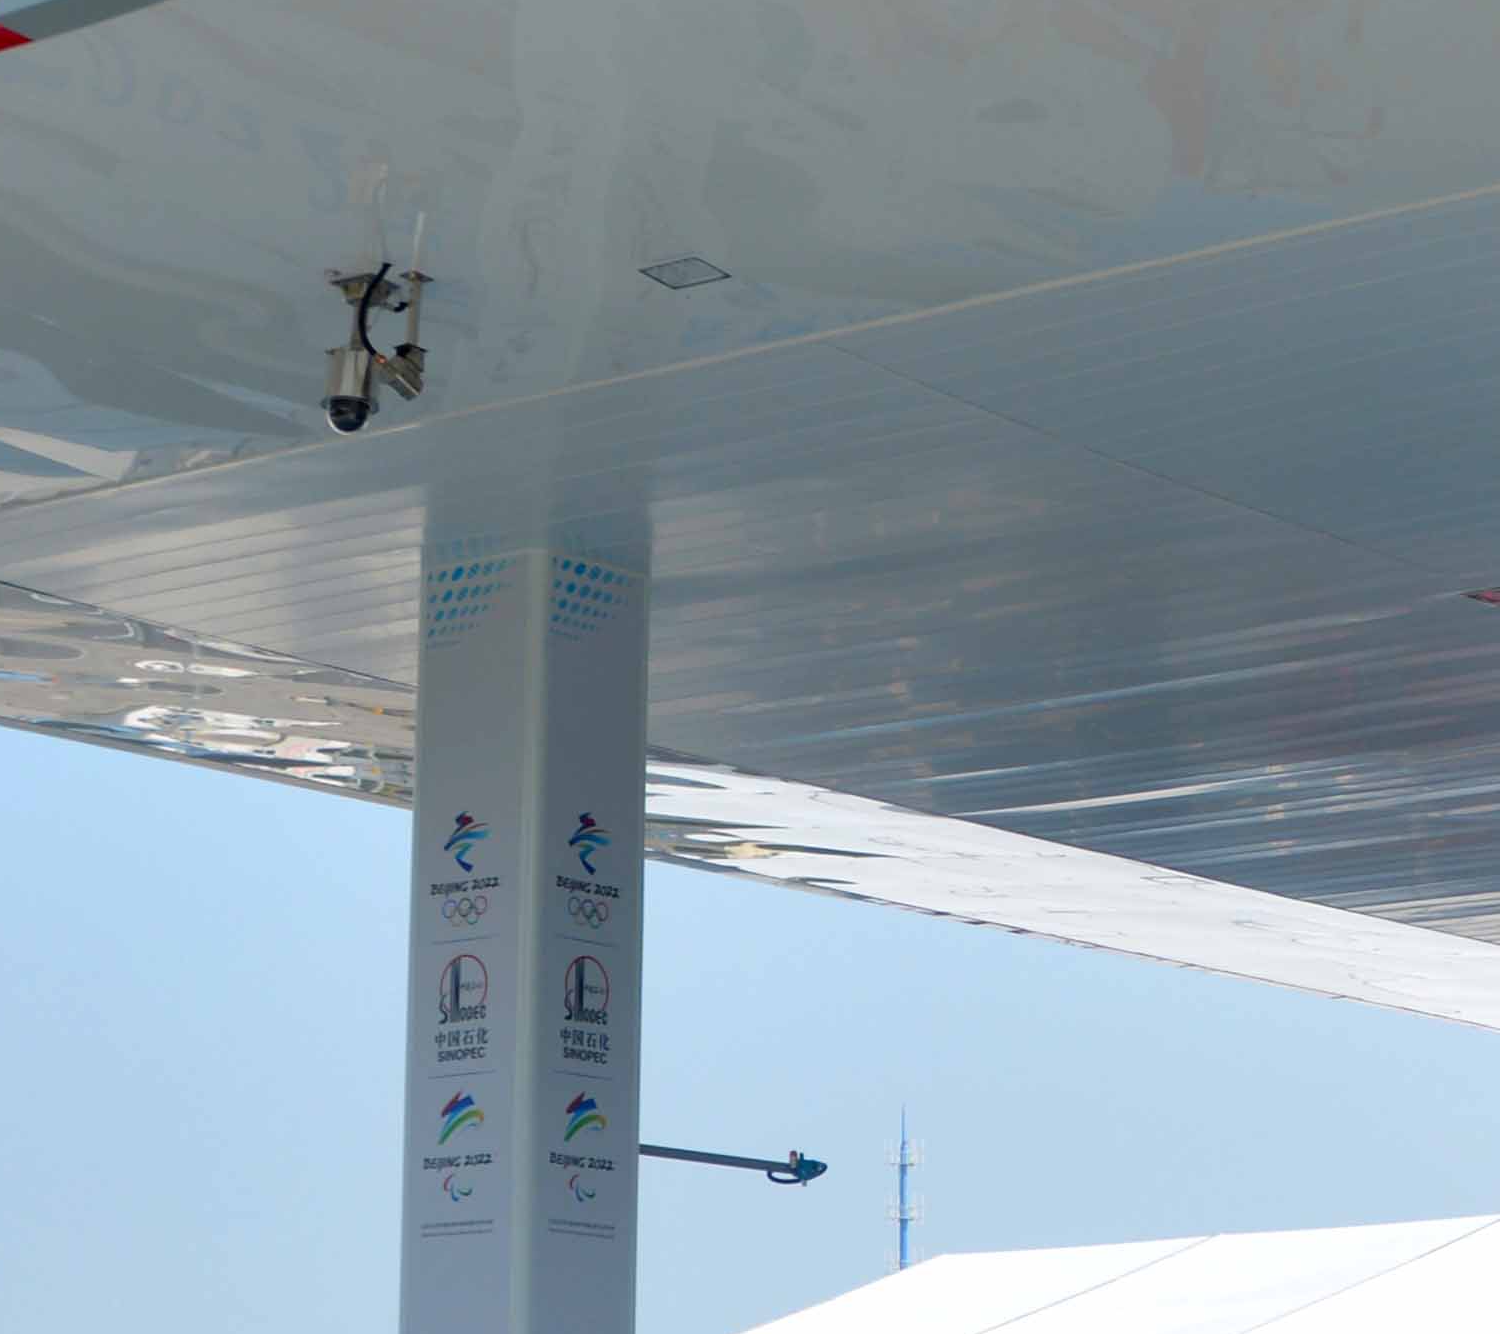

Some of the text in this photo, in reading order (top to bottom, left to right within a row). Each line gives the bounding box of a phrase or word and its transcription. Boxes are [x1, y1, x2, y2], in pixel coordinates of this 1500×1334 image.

[435, 1026, 490, 1048] 中国石化
[559, 1025, 610, 1052] 中国石化
[437, 1046, 487, 1063] SINOPEC
[563, 1046, 608, 1065] SINOPEC
